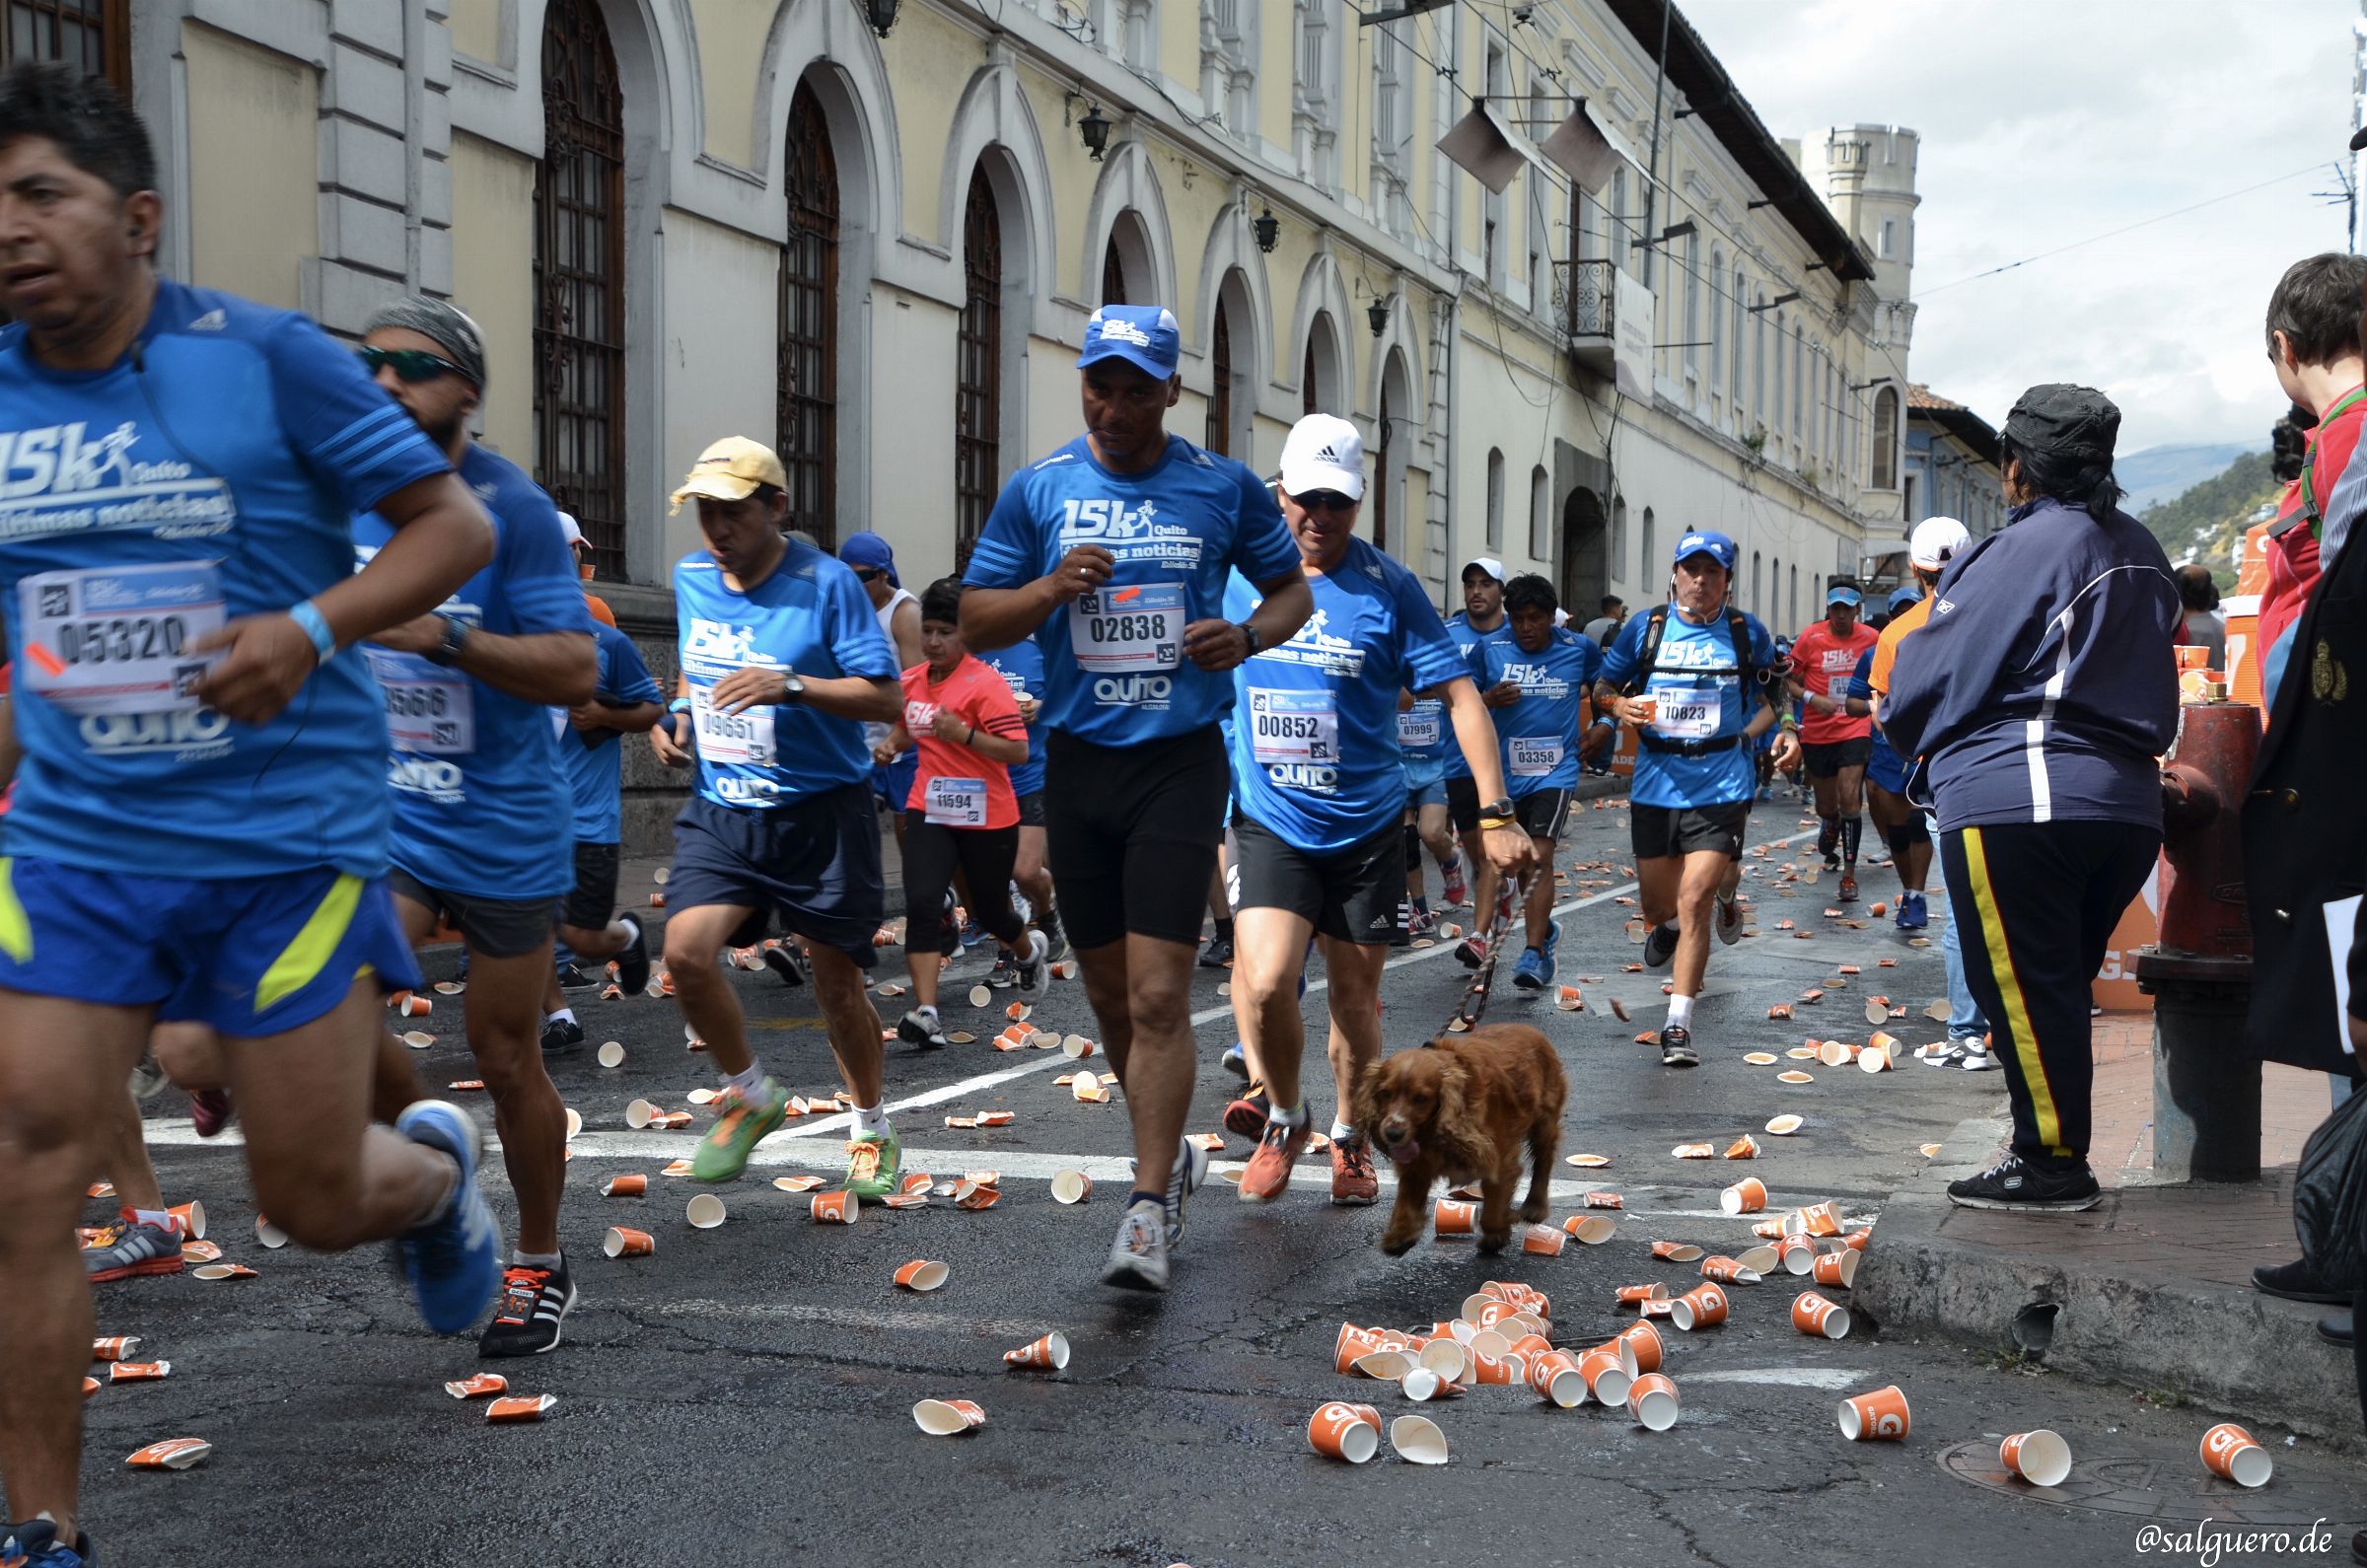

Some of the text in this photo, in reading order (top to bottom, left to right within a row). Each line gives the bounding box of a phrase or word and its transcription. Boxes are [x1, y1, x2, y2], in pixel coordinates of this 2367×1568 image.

[1059, 499, 1138, 538] 15k
[1154, 525, 1188, 536] Quito
[1131, 543, 1200, 559] noticias
[1090, 613, 1167, 643] 02838
[59, 615, 186, 665] 05320
[1655, 641, 1703, 668] 15k
[1500, 663, 1539, 684] 15k
[1665, 706, 1706, 721] 10823
[1259, 715, 1319, 739] 00852
[1403, 724, 1433, 736] 07999
[1518, 750, 1555, 763] 03358
[937, 793, 972, 809] 11594
[1701, 1291, 1723, 1312] G
[1800, 1295, 1821, 1314] G
[1481, 1306, 1498, 1325] G
[2209, 1429, 2236, 1453] G
